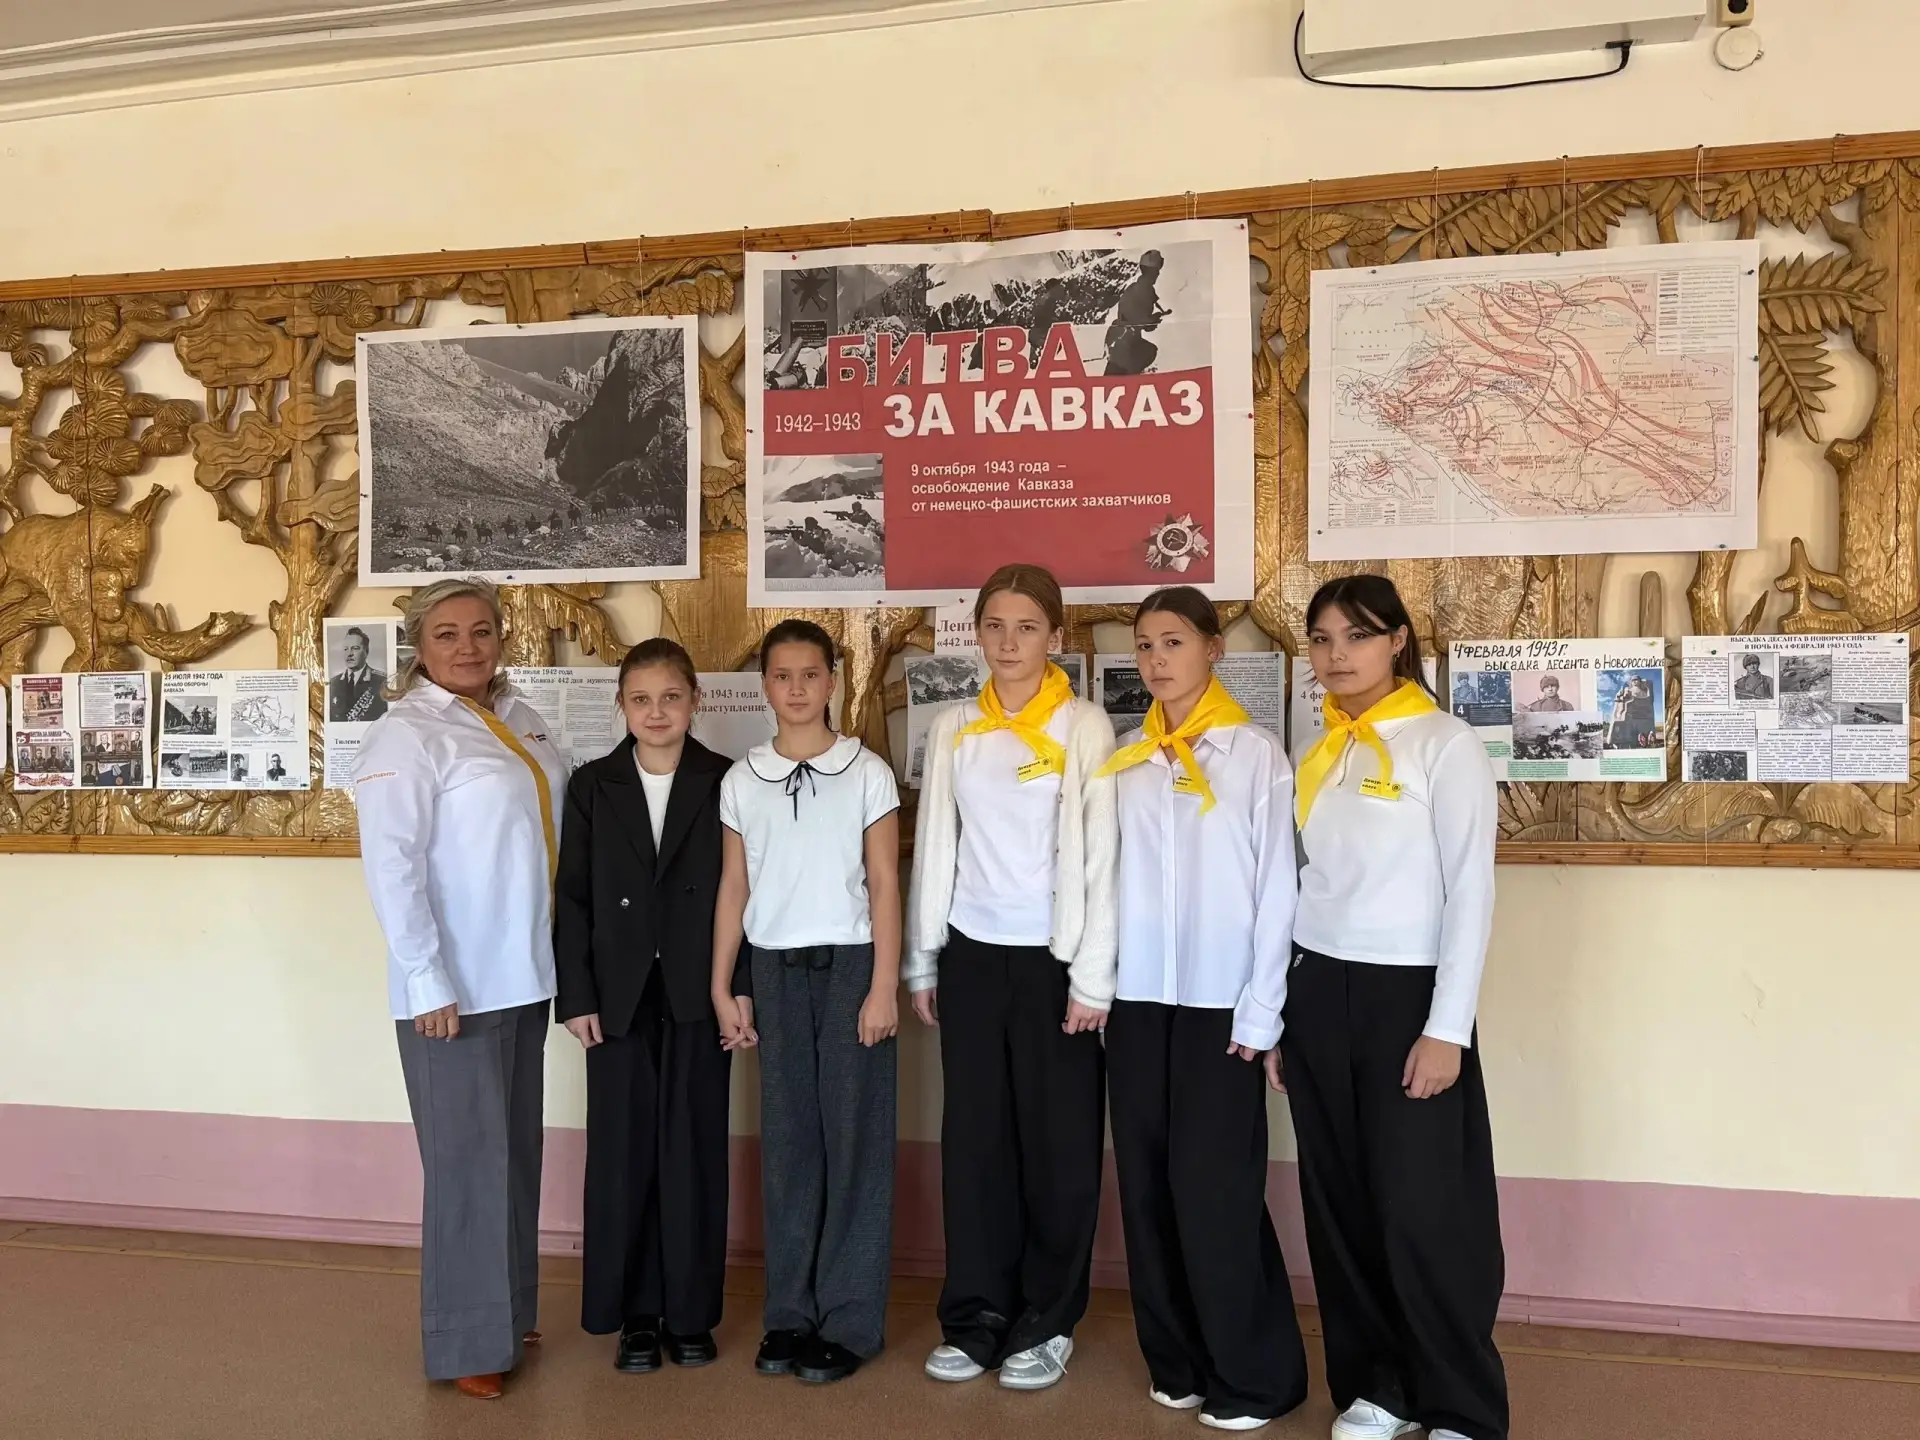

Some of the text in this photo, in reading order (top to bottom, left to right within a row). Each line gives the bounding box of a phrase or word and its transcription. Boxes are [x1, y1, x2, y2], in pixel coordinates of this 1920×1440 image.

[826, 322, 1089, 389] БИТВА
[884, 380, 1204, 437] ЗА КАВКАЗ
[911, 465, 919, 477] 9
[922, 464, 977, 478] октября
[984, 460, 1015, 474] 1943
[1018, 461, 1050, 475] года
[911, 478, 1074, 495] освобождение Кавказа
[911, 493, 1172, 513] от немецко-фашистских захватчиков
[936, 619, 975, 633] Лент
[963, 639, 979, 647] ша
[172, 672, 191, 680] ИЮЛЯ
[206, 672, 224, 680] ГОДА
[710, 688, 733, 699] 1943
[735, 690, 760, 699] года
[1300, 690, 1324, 702] 4 фе
[695, 703, 768, 715] рнаступление
[1457, 704, 1465, 715] 4
